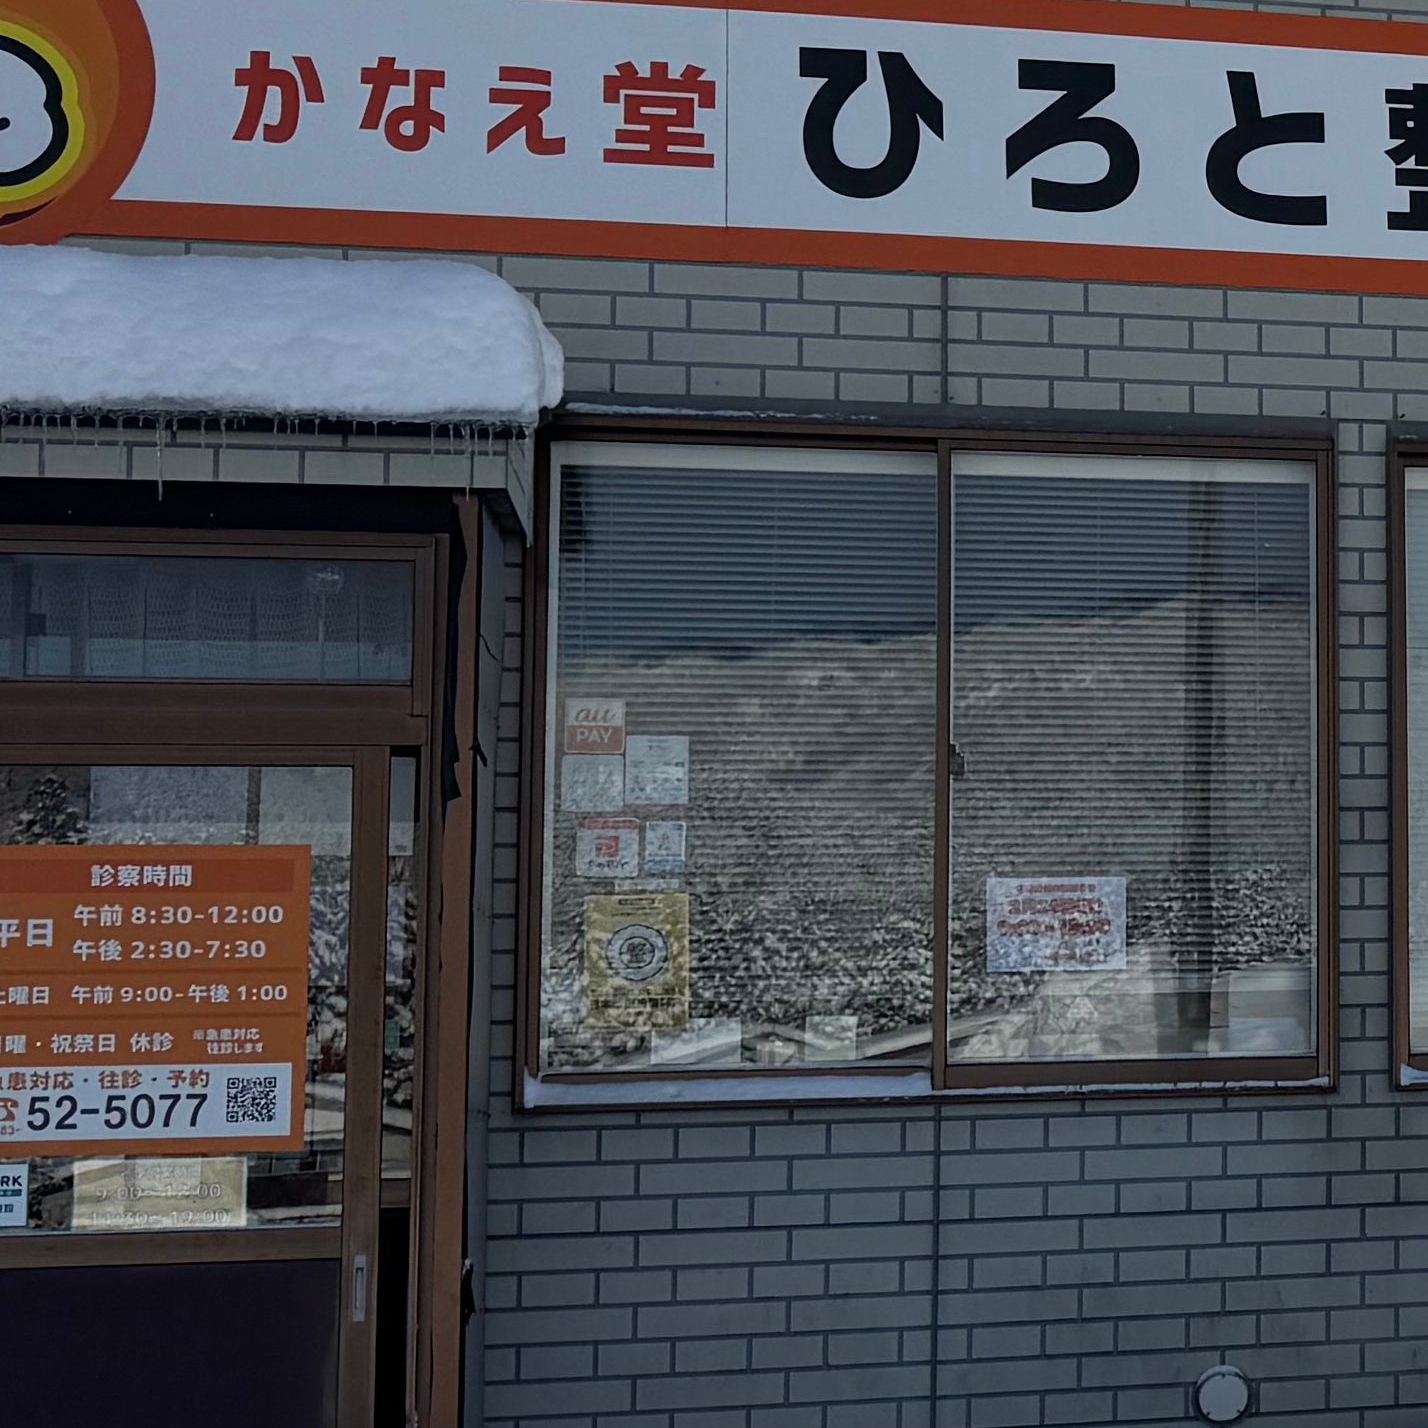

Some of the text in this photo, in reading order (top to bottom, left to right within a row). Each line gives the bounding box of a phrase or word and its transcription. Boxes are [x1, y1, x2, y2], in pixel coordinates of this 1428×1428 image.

[233, 49, 717, 168] かなえ堂
[576, 728, 613, 744] PAY
[90, 864, 194, 888] 診察時間
[73, 904, 284, 928] 午前 8:30-12:00
[0, 918, 55, 949] 平日
[72, 940, 267, 962] 午後 2:30-7:30
[71, 985, 113, 1006] 午前
[237, 984, 288, 1002] 1:00
[0, 1032, 175, 1054] 曜・祝祭日 休診
[0, 1069, 211, 1092] 患対応・往診・予約
[26, 1092, 210, 1132] 52-5077
